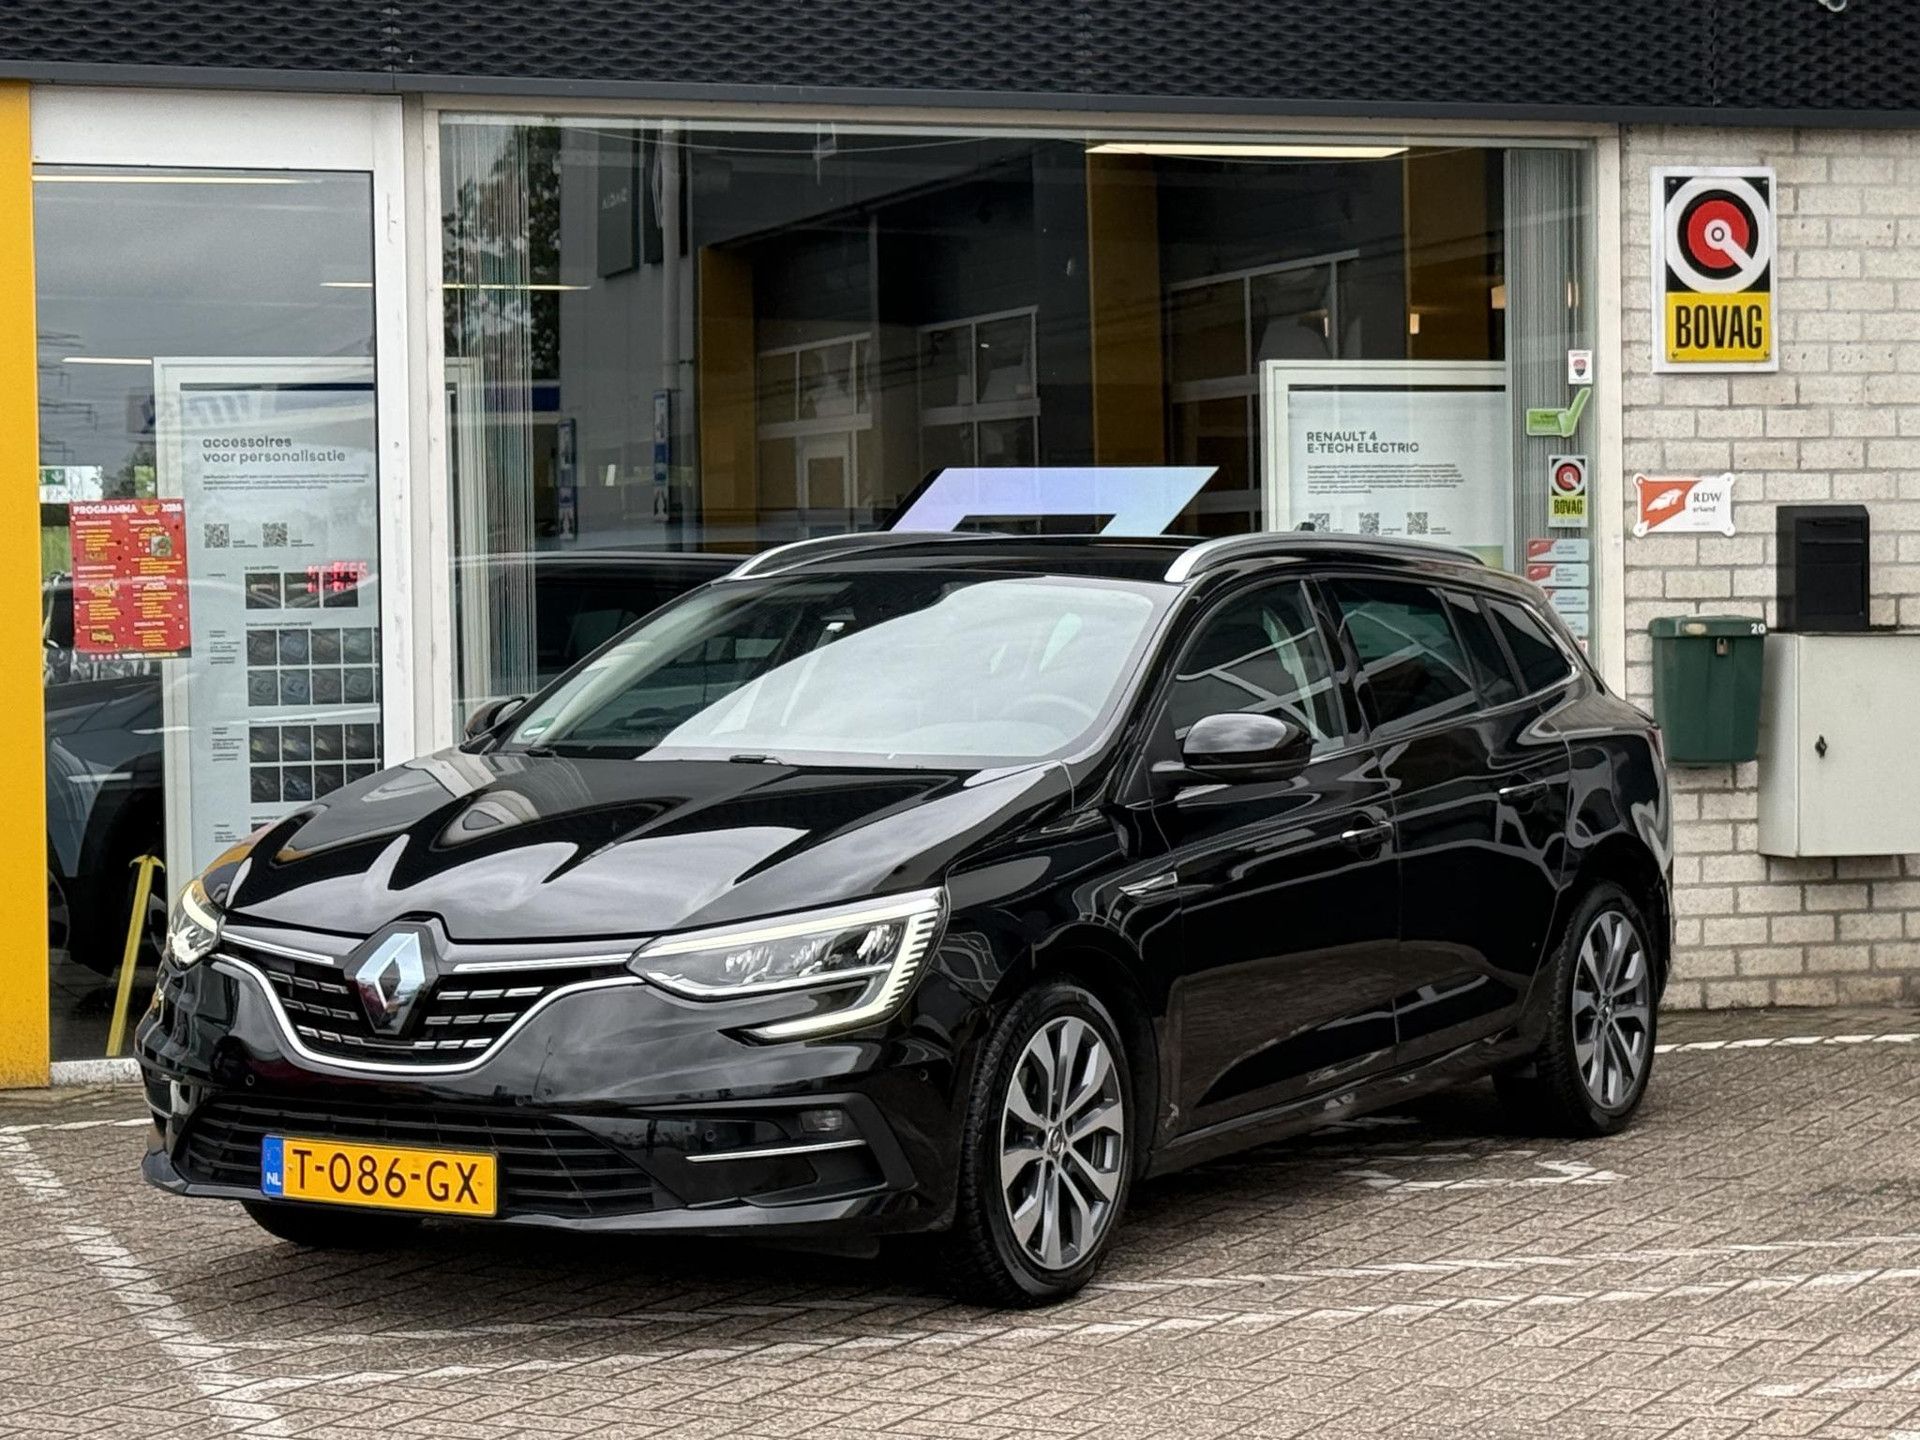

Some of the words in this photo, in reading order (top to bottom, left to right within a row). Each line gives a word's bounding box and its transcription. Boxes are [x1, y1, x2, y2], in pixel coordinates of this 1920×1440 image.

[1675, 304, 1762, 349] BOVAG
[202, 435, 292, 448] accessoires
[1307, 431, 1367, 442] RENAULT
[1369, 431, 1378, 441] 4
[1307, 443, 1354, 454] E-TECH
[1357, 442, 1420, 453] ELECTRIC
[203, 451, 236, 462] voor
[239, 449, 346, 465] personalisatie
[1693, 492, 1721, 502] RDW
[72, 504, 138, 515] PROGRAMMA
[1553, 499, 1583, 514] BOVAG
[1751, 623, 1766, 635] 20
[266, 1171, 281, 1186] NL
[292, 1149, 479, 1205] T-086-GX
